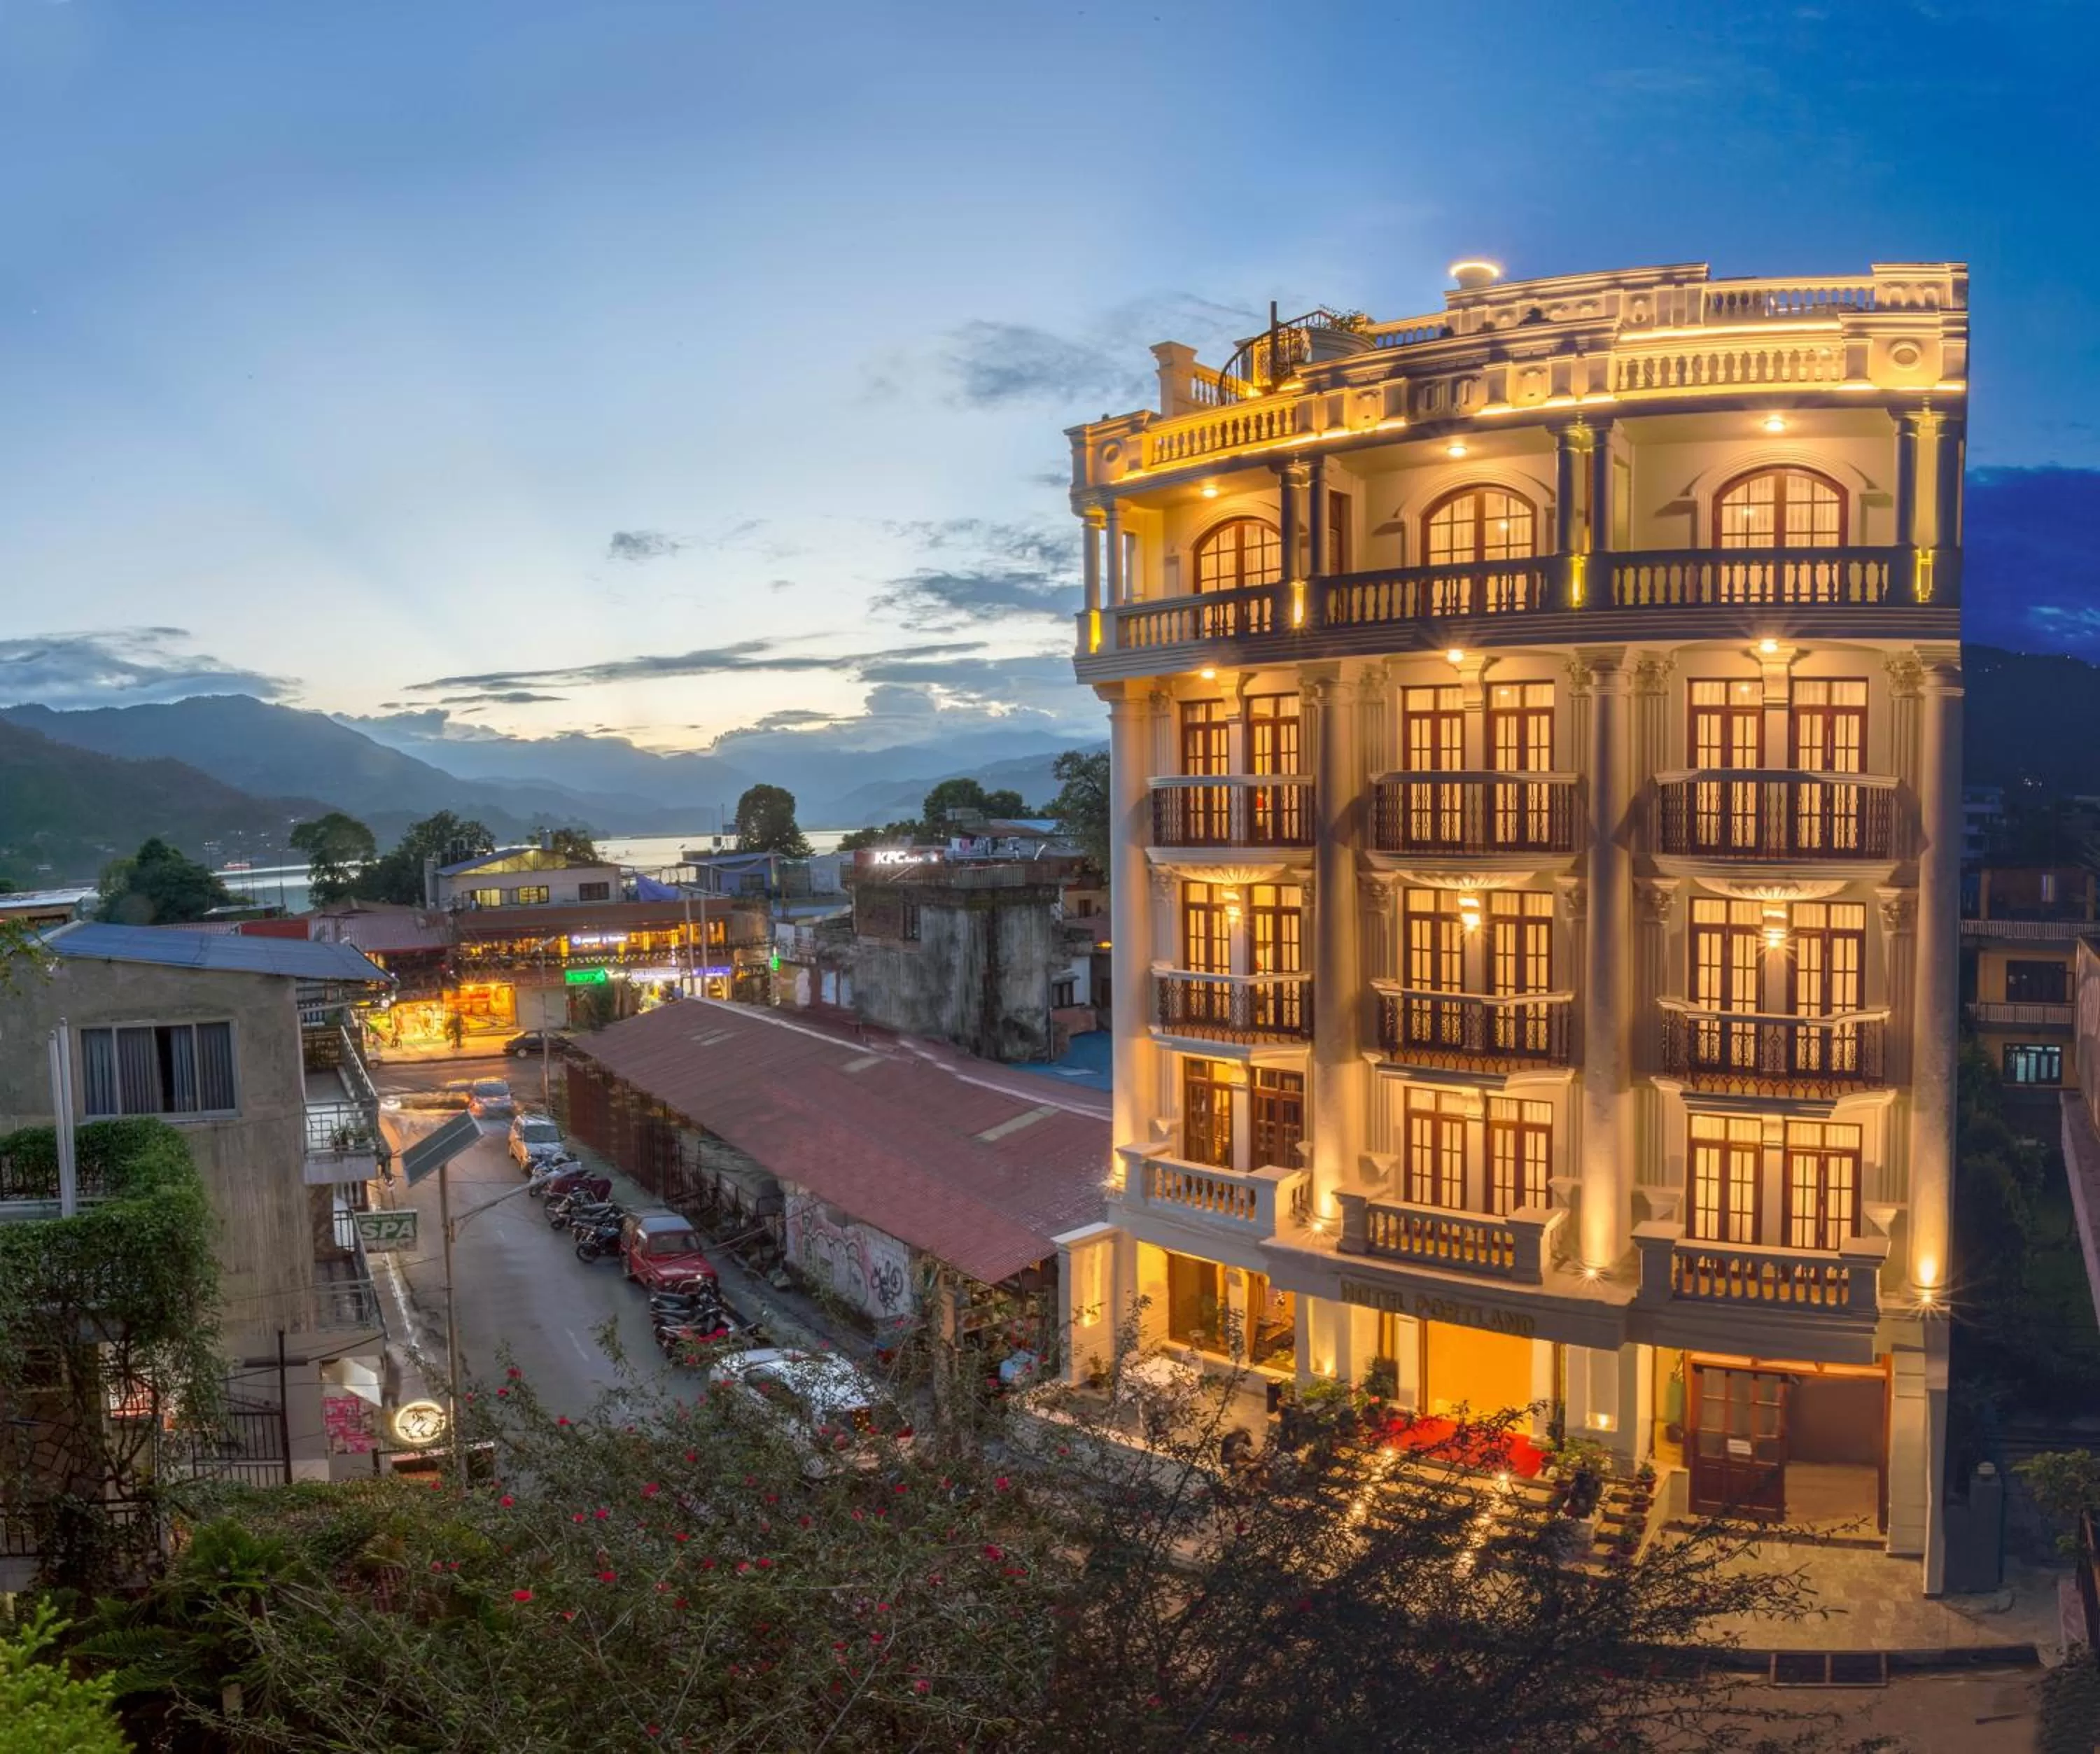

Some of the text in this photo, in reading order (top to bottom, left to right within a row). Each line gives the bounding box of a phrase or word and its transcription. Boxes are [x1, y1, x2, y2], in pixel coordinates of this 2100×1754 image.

[874, 851, 906, 864] KFC
[360, 1221, 415, 1240] SPA
[1341, 1280, 1535, 1335] HOTEL PORTLAND
